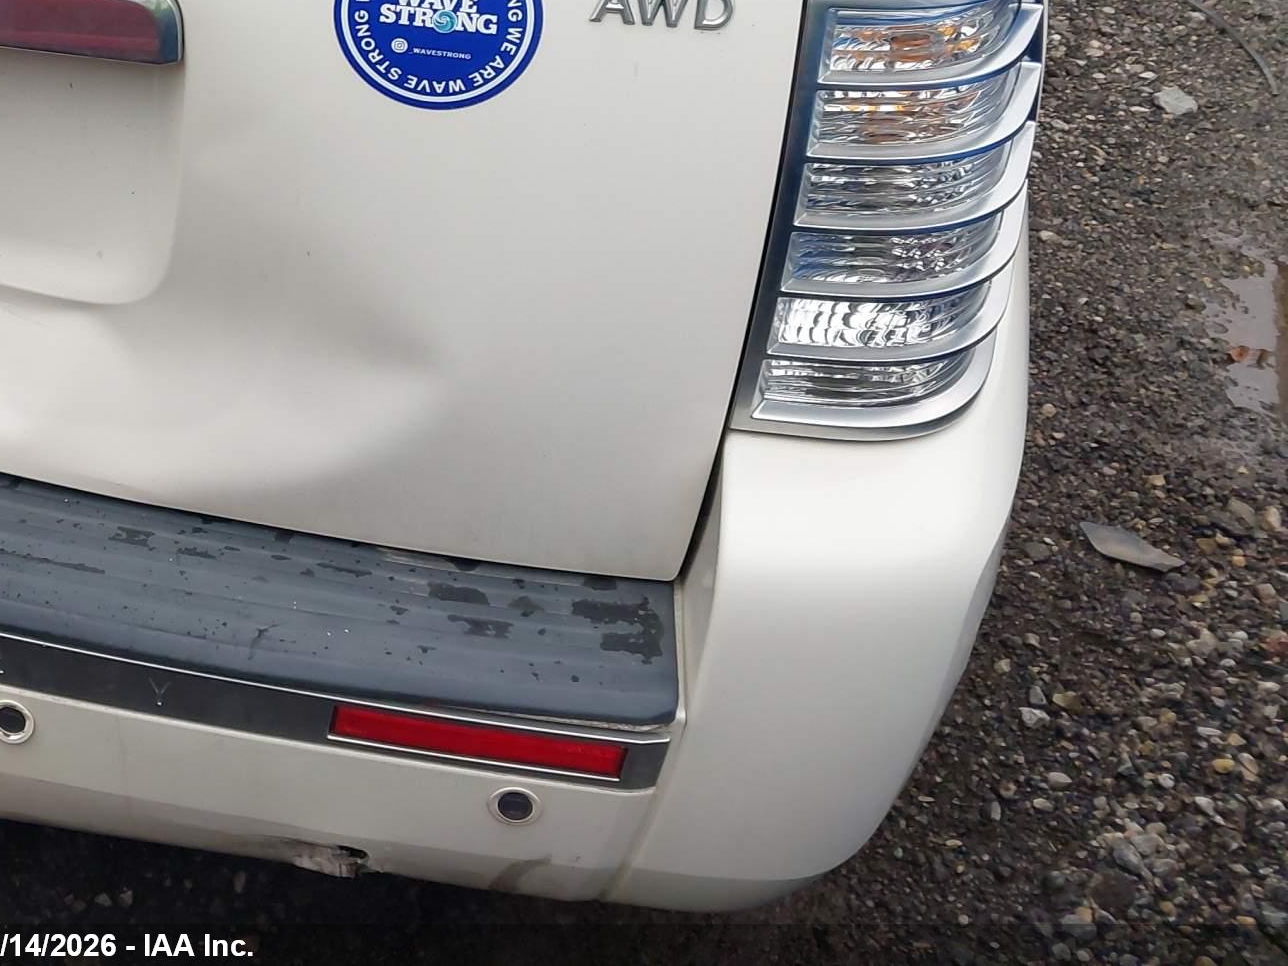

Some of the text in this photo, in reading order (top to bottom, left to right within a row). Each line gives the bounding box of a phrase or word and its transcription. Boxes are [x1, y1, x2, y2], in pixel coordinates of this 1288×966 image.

[354, 9, 524, 94] WE ARE WAVE STRONG
